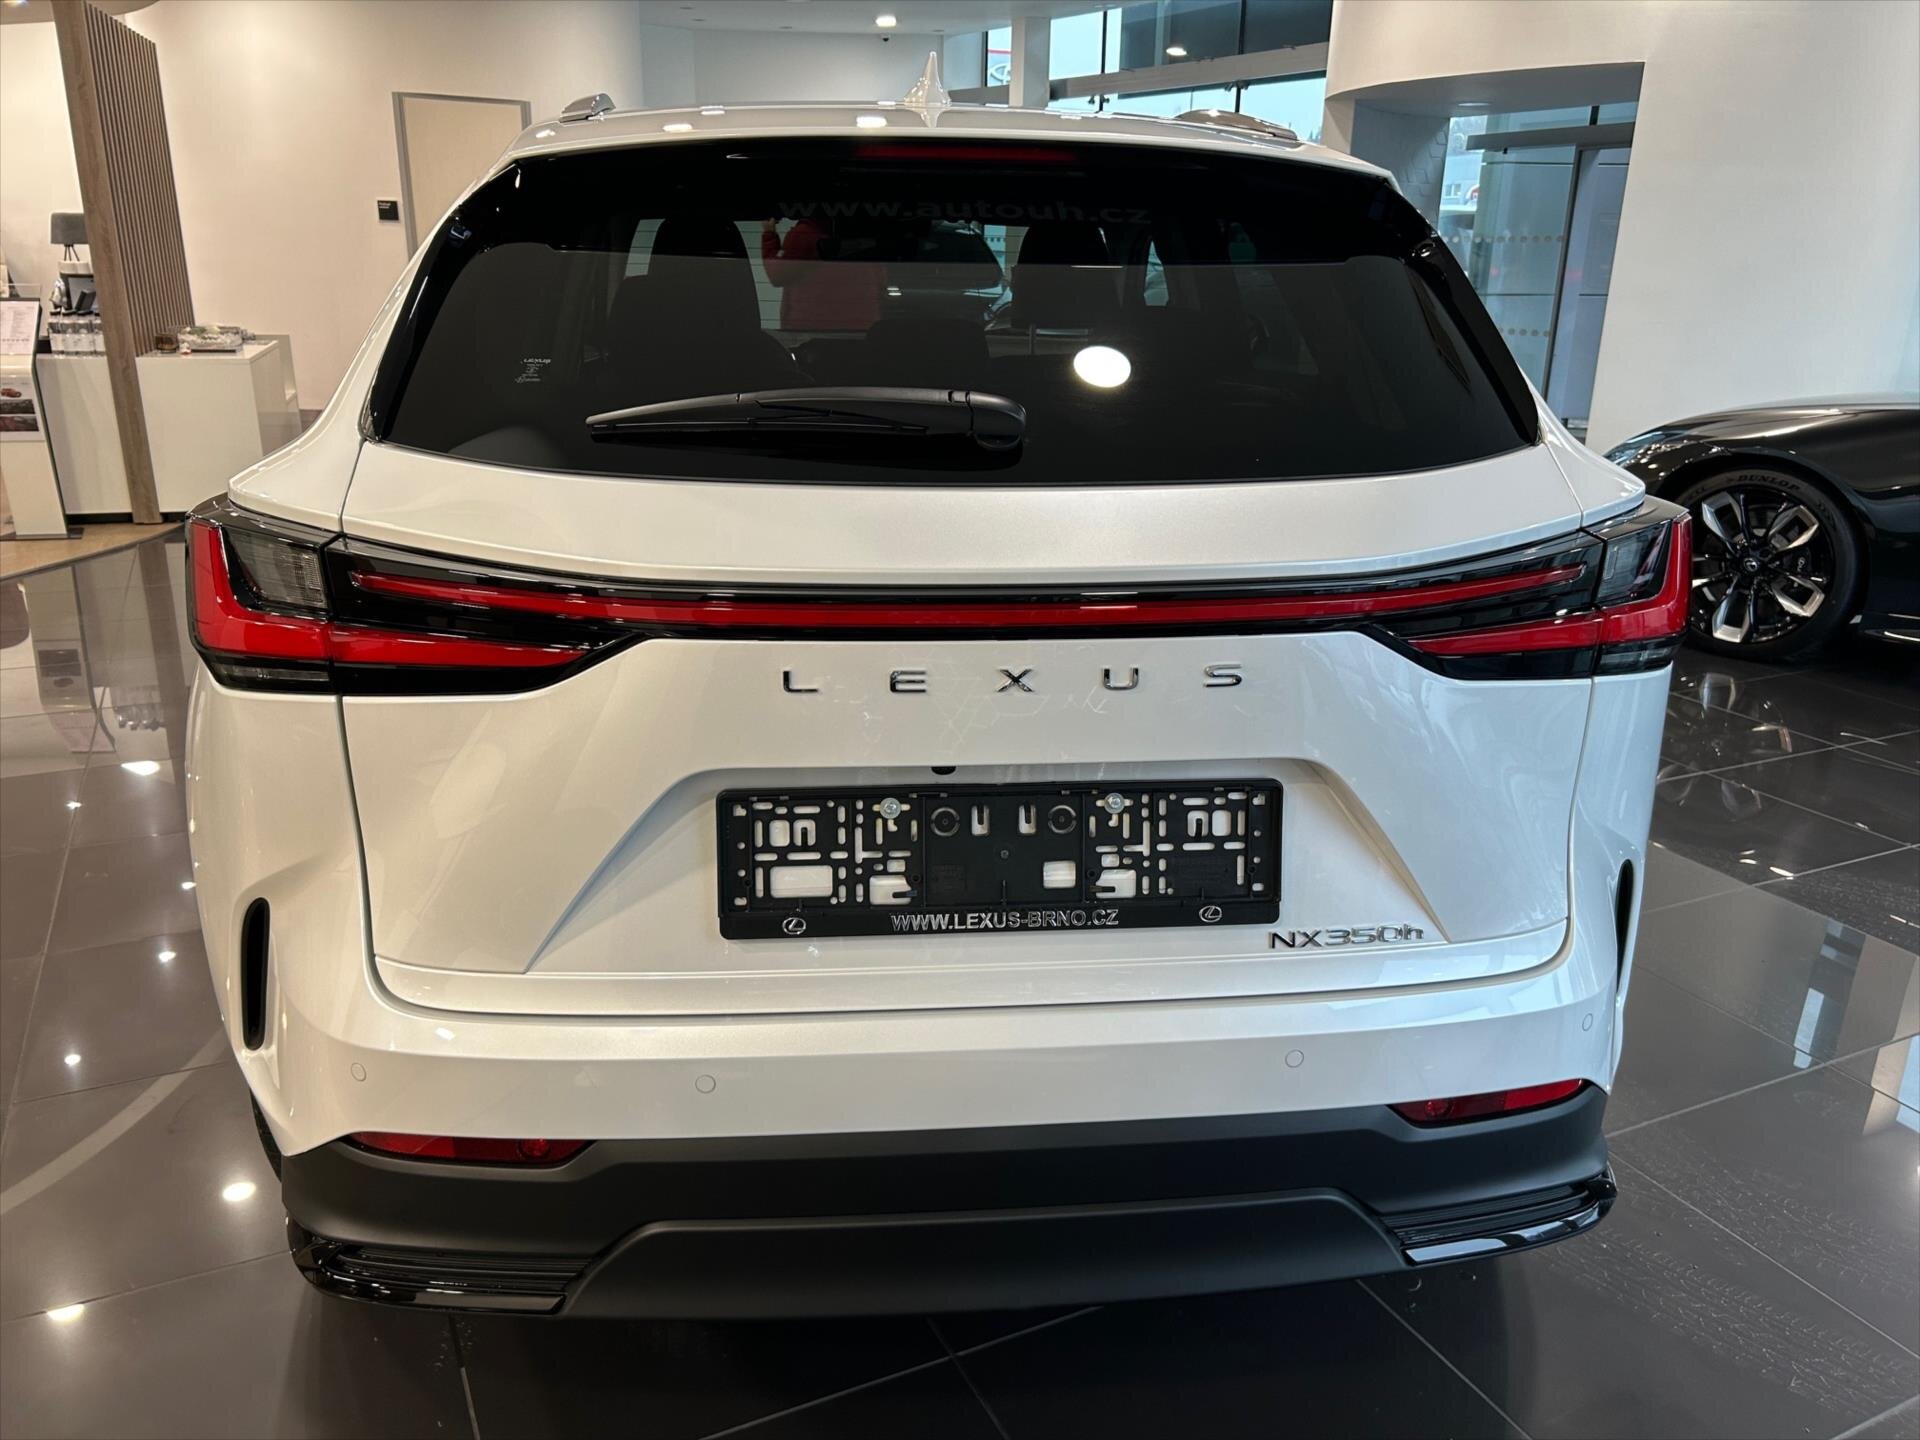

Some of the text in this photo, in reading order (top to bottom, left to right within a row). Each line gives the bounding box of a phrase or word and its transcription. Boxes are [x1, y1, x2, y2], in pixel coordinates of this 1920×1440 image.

[778, 200, 1151, 225] www.autouh.cz
[1737, 475, 1800, 491] DUNLOP
[783, 664, 1242, 693] LEXUS
[891, 908, 1119, 931] WWW.LEXUS-BRNO.CZ
[1268, 923, 1424, 949] NX350h
